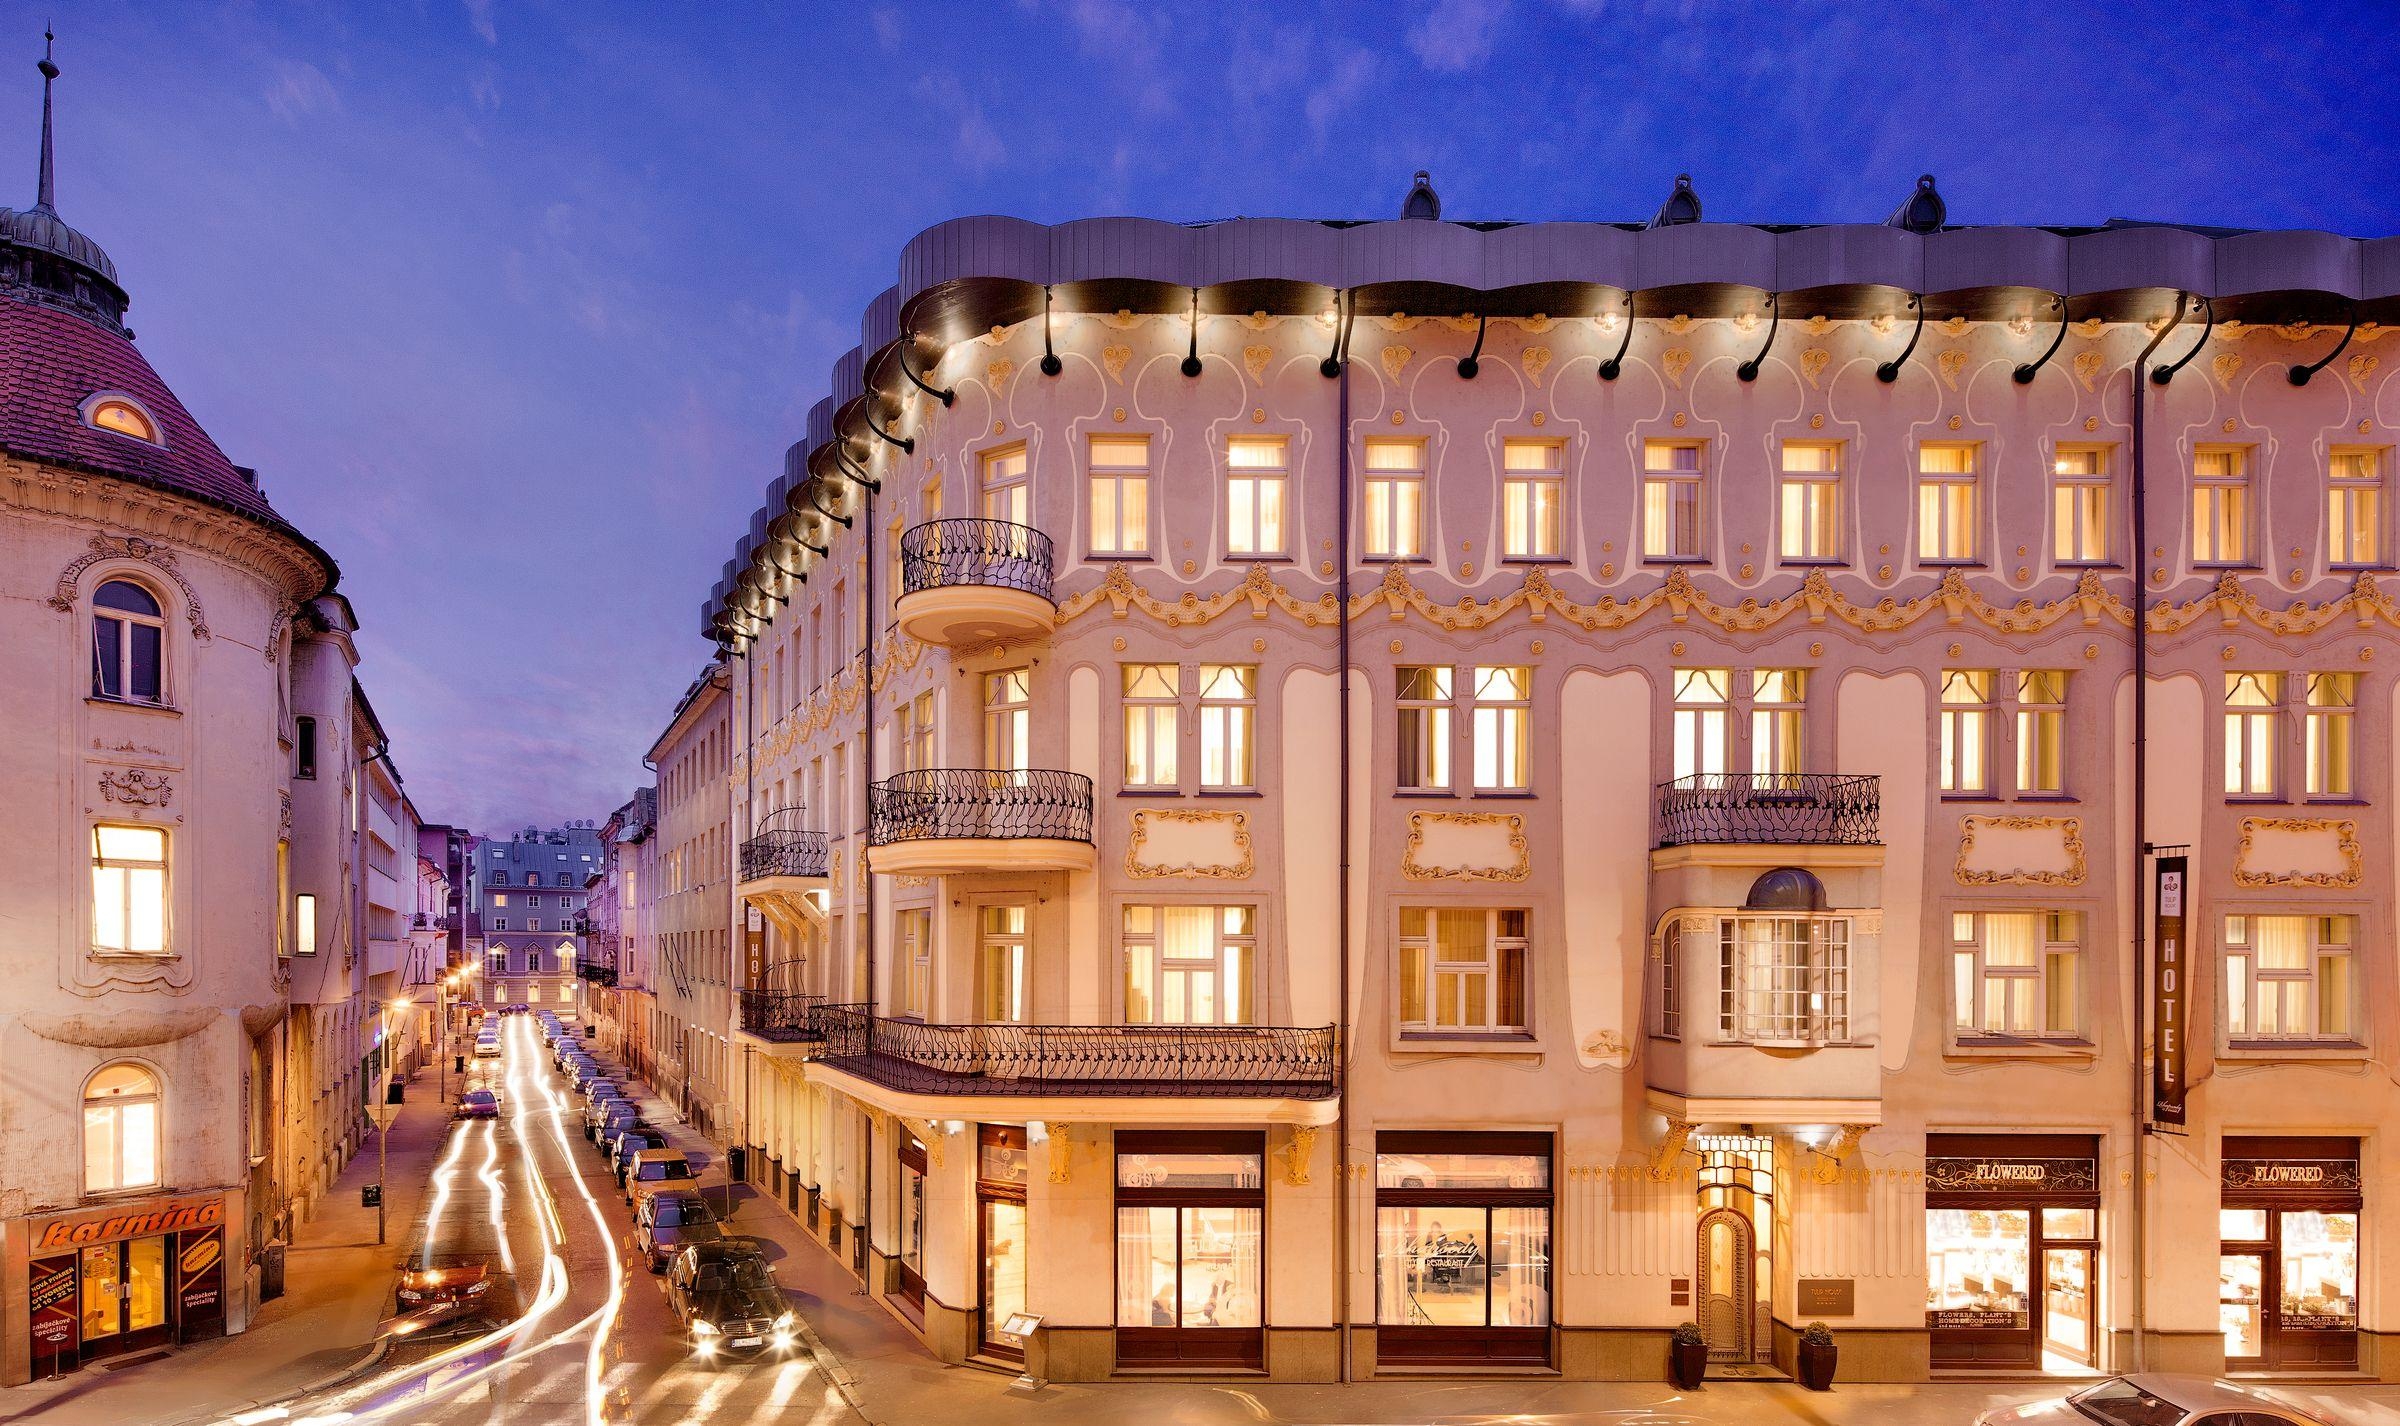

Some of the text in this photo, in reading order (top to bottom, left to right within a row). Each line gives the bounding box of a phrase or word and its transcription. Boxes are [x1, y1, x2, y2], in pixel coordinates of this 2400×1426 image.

[2163, 939, 2176, 1083] HOTEL
[1976, 1164, 2045, 1180] FLOWERED
[2255, 1166, 2323, 1181] FLOWERED
[38, 1203, 222, 1249] karmina
